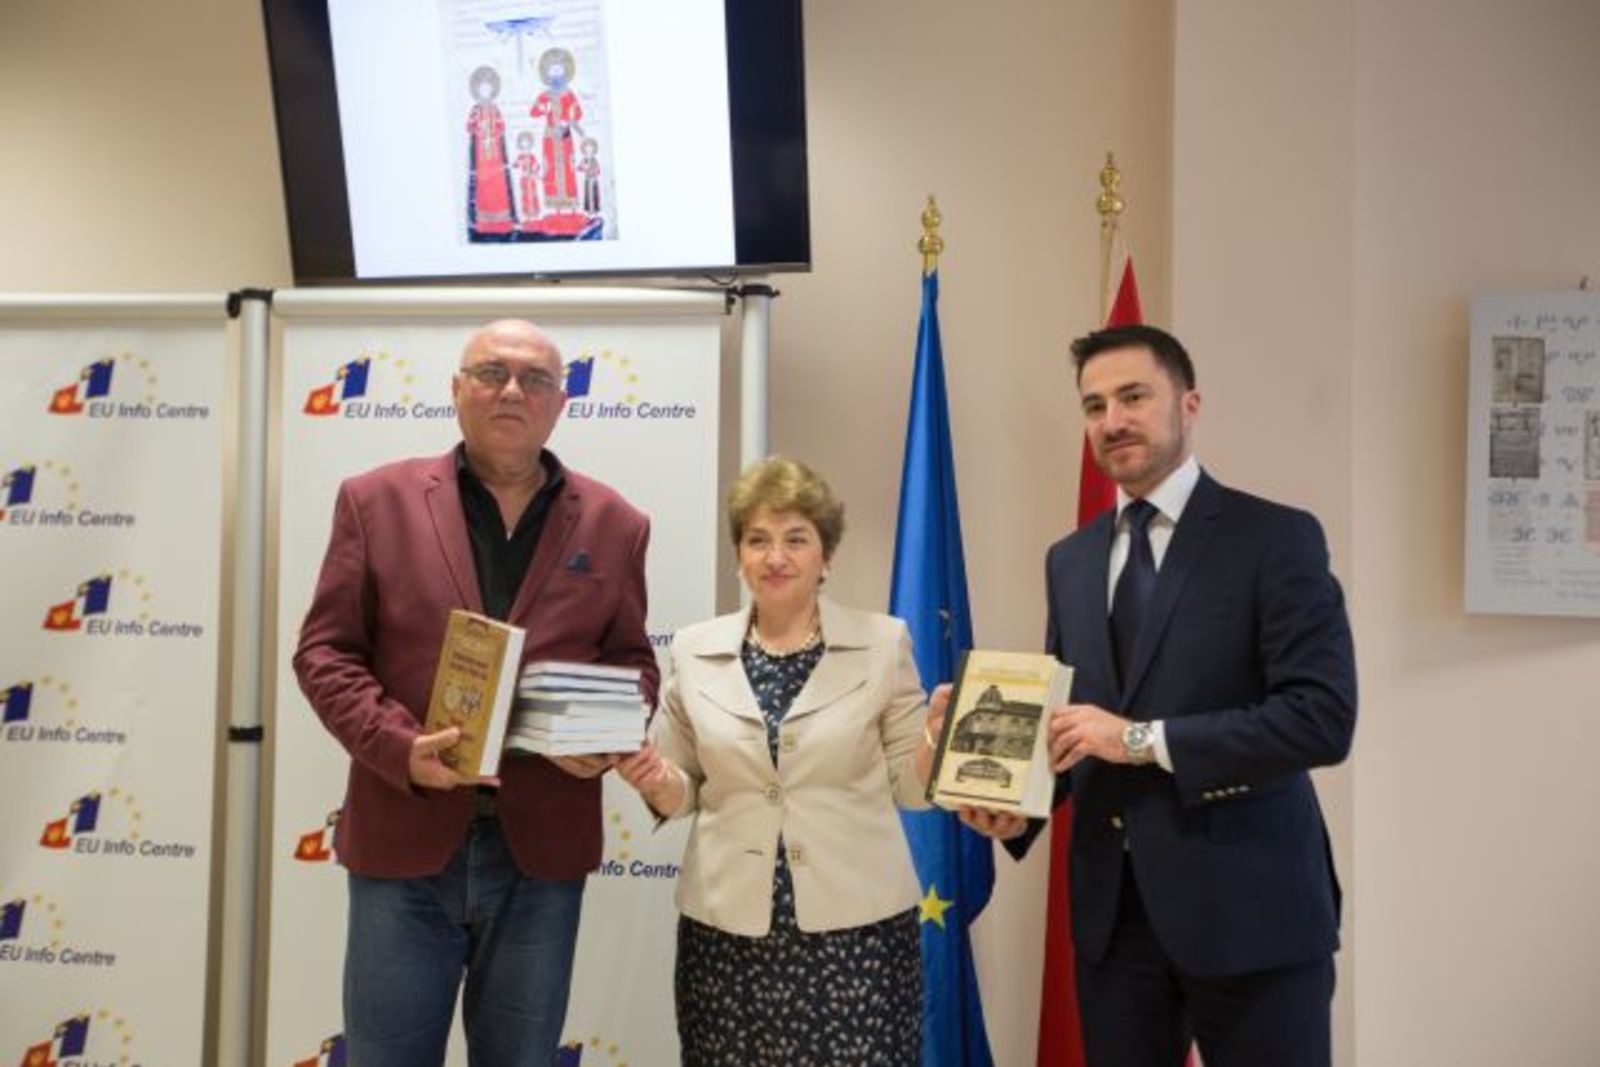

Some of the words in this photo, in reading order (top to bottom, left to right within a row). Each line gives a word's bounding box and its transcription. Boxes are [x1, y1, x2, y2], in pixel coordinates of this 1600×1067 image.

[88, 402, 114, 418] EU
[118, 403, 151, 419] Info
[156, 403, 209, 419] Centre
[344, 402, 370, 419] EU
[374, 402, 407, 419] Info
[567, 402, 593, 418] EU
[597, 402, 631, 418] Info
[637, 402, 696, 418] Centre
[10, 510, 35, 525] EU
[39, 511, 73, 525] Info
[78, 510, 135, 526] Centre
[86, 619, 112, 635] EU
[115, 620, 143, 636] Info
[149, 622, 203, 637] Centre
[6, 726, 33, 741] EU
[38, 726, 71, 741] Info
[75, 727, 126, 743] Centre
[75, 837, 100, 853] EU
[102, 839, 135, 855] Info
[139, 841, 195, 858] Centre
[24, 946, 56, 963] Info
[60, 947, 116, 966] Centre
